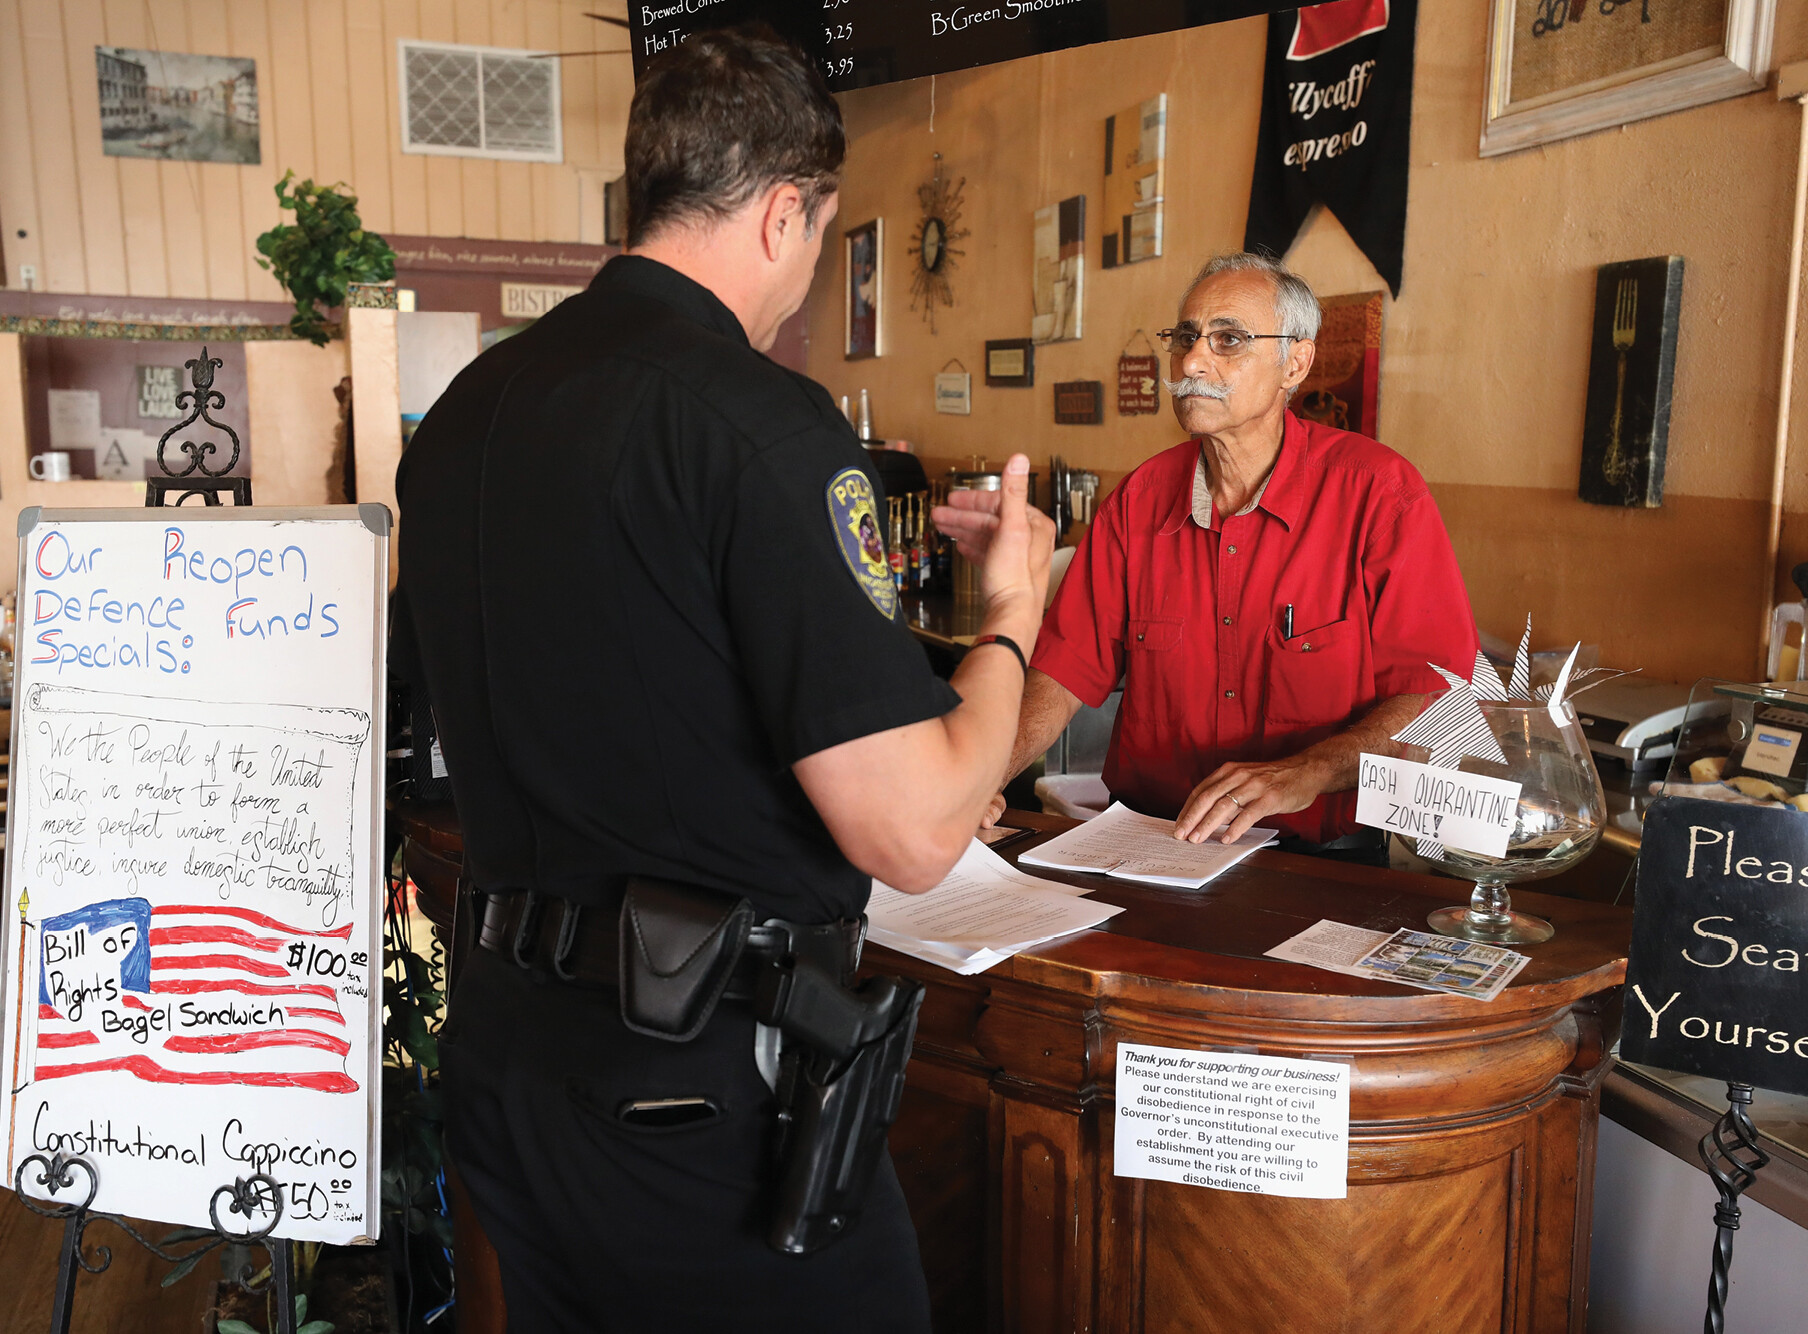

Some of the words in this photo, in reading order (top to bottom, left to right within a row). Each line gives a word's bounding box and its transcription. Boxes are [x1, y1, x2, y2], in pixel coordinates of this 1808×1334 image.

[642, 2, 683, 26] Brewed
[931, 6, 1000, 36] B-Green
[644, 34, 668, 56] Hot
[668, 28, 692, 47] Te
[825, 22, 853, 44] 3.25
[826, 57, 854, 78] 3.95
[1288, 59, 1376, 121] illycaff
[1283, 120, 1367, 172] espreo
[507, 287, 578, 312] BISTR
[143, 383, 177, 401] LOVE
[145, 366, 176, 384] LIVE
[833, 478, 872, 507] POL
[35, 530, 103, 580] Our
[163, 527, 308, 599] Reopen
[33, 588, 186, 631] Defence
[225, 592, 340, 640] Funds
[31, 628, 194, 675] Specials:
[38, 720, 77, 760] We
[79, 721, 124, 764] the
[127, 723, 196, 774] People
[204, 739, 221, 783] of
[228, 743, 258, 779] the
[270, 744, 334, 789] United
[102, 777, 121, 800] in
[135, 770, 185, 805] order
[191, 778, 225, 808] to
[230, 782, 281, 824] form
[296, 801, 309, 815] a
[1361, 759, 1397, 795] CASH
[1414, 773, 1516, 828] QUARANTINE
[40, 817, 86, 836] more
[97, 807, 183, 849] perfect
[1385, 802, 1444, 839] ZONE!
[43, 929, 85, 965] Bill
[286, 940, 347, 978] $100
[1681, 915, 1808, 972] Sea
[50, 970, 118, 1022] Rights
[346, 970, 361, 983] tax
[102, 1002, 172, 1044] Bagel
[179, 1002, 287, 1028] Sandwich
[1125, 1050, 1157, 1064] Thank
[1156, 1058, 1178, 1067] you
[1179, 1058, 1197, 1069] for
[1196, 1061, 1260, 1078] supporting
[1261, 1068, 1283, 1078] our
[1283, 1068, 1341, 1083] business!
[1125, 1065, 1160, 1079] Please
[1163, 1073, 1228, 1087] understand
[1231, 1080, 1249, 1089] we
[1251, 1081, 1271, 1091] are
[1274, 1084, 1337, 1100] exercising
[1136, 1095, 1211, 1114] disobedience
[1214, 1105, 1225, 1115] in
[1227, 1108, 1284, 1121] response
[1287, 1112, 1298, 1123] to
[1301, 1114, 1321, 1125] the
[1142, 1083, 1161, 1093] our
[1163, 1087, 1242, 1103] constitutional
[1245, 1094, 1273, 1107] right
[1276, 1097, 1288, 1107] of
[1291, 1100, 1315, 1110] civil
[33, 1100, 206, 1167] Constitutional
[1120, 1106, 1181, 1124] Governor's
[1183, 1117, 1278, 1136] unconstitutional
[1281, 1128, 1339, 1141] executive
[1157, 1128, 1191, 1140] order.
[1197, 1131, 1213, 1145] By
[1215, 1134, 1272, 1152] attending
[1275, 1142, 1296, 1152] our
[1136, 1138, 1214, 1158] establishment
[1217, 1150, 1238, 1161] you
[1241, 1153, 1261, 1163] are
[1264, 1155, 1303, 1170] willing
[1306, 1158, 1318, 1169] to
[1148, 1154, 1191, 1168] assume
[1194, 1159, 1212, 1171] the
[1214, 1163, 1237, 1175] risk
[1239, 1166, 1252, 1176] of
[1254, 1167, 1276, 1179] this
[1279, 1171, 1304, 1182] civil
[1182, 1173, 1264, 1193] disobedience.
